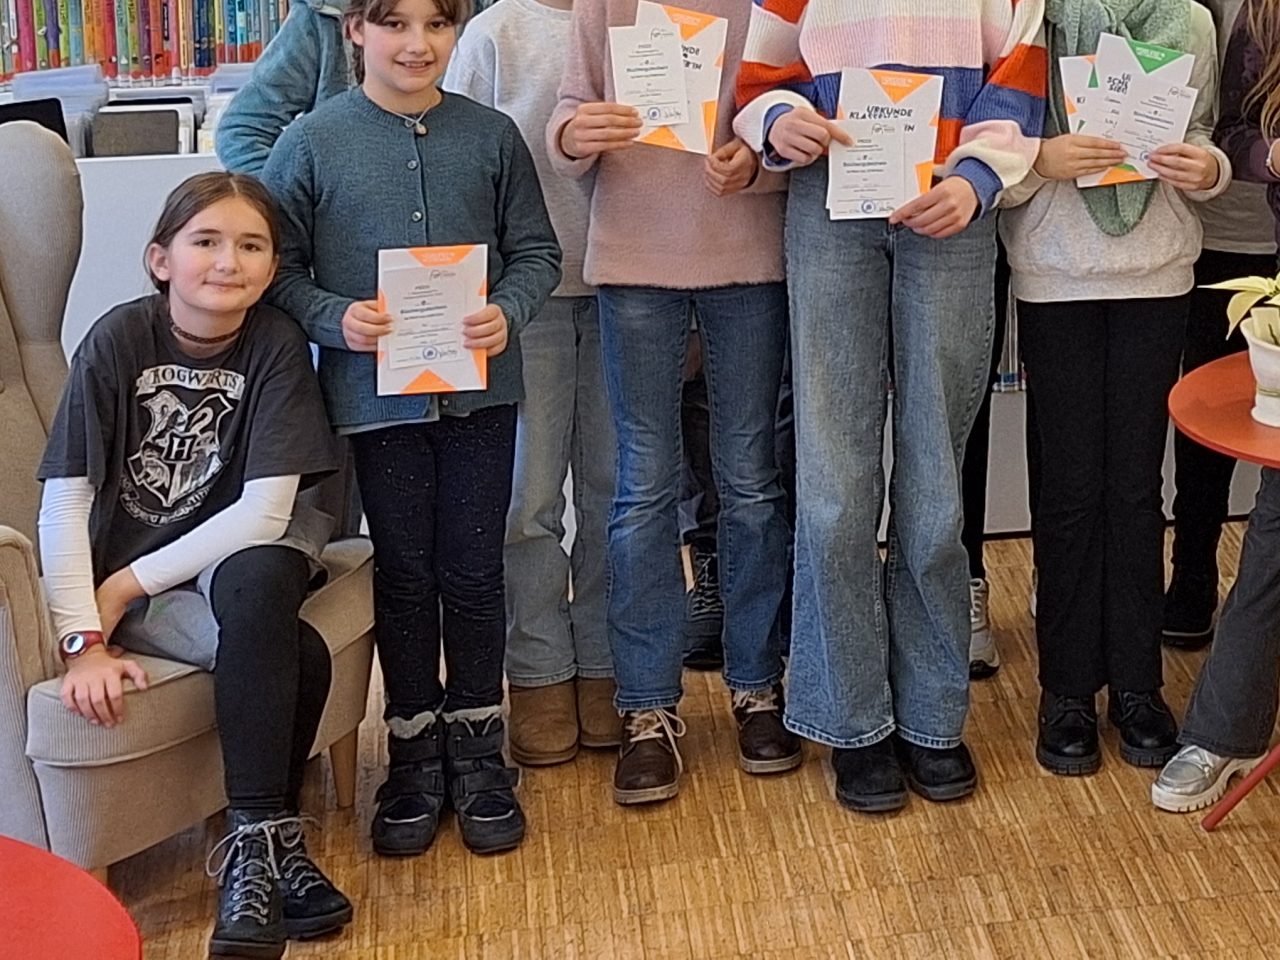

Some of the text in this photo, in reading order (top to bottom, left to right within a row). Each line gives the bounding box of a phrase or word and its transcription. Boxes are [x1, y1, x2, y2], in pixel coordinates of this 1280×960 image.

[866, 106, 913, 118] URKUNDE
[151, 367, 240, 389] HOGWARTS
[169, 438, 196, 460] H
